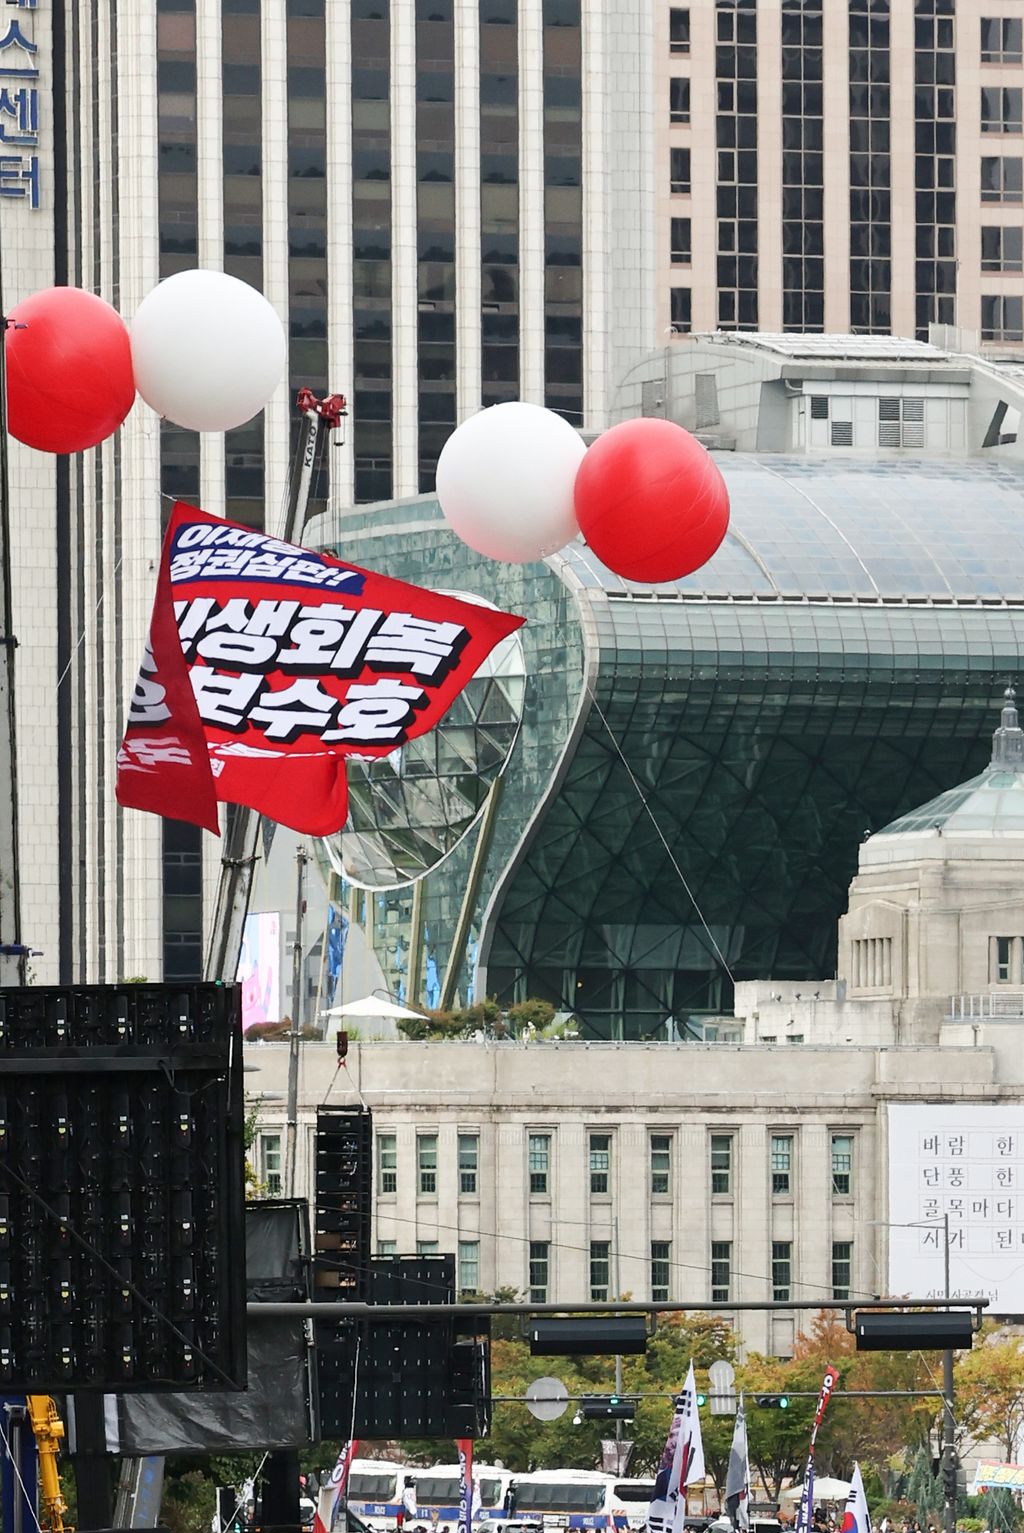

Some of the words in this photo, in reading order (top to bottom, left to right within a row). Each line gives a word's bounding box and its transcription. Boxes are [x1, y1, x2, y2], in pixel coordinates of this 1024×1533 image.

[303, 425, 320, 470] KATO
[923, 1136, 966, 1157] 바람
[997, 1136, 1014, 1156] 한
[923, 1167, 965, 1187] 단풍
[997, 1167, 1014, 1187] 한
[923, 1198, 1014, 1219] 골목마다
[923, 1229, 966, 1250] 시가
